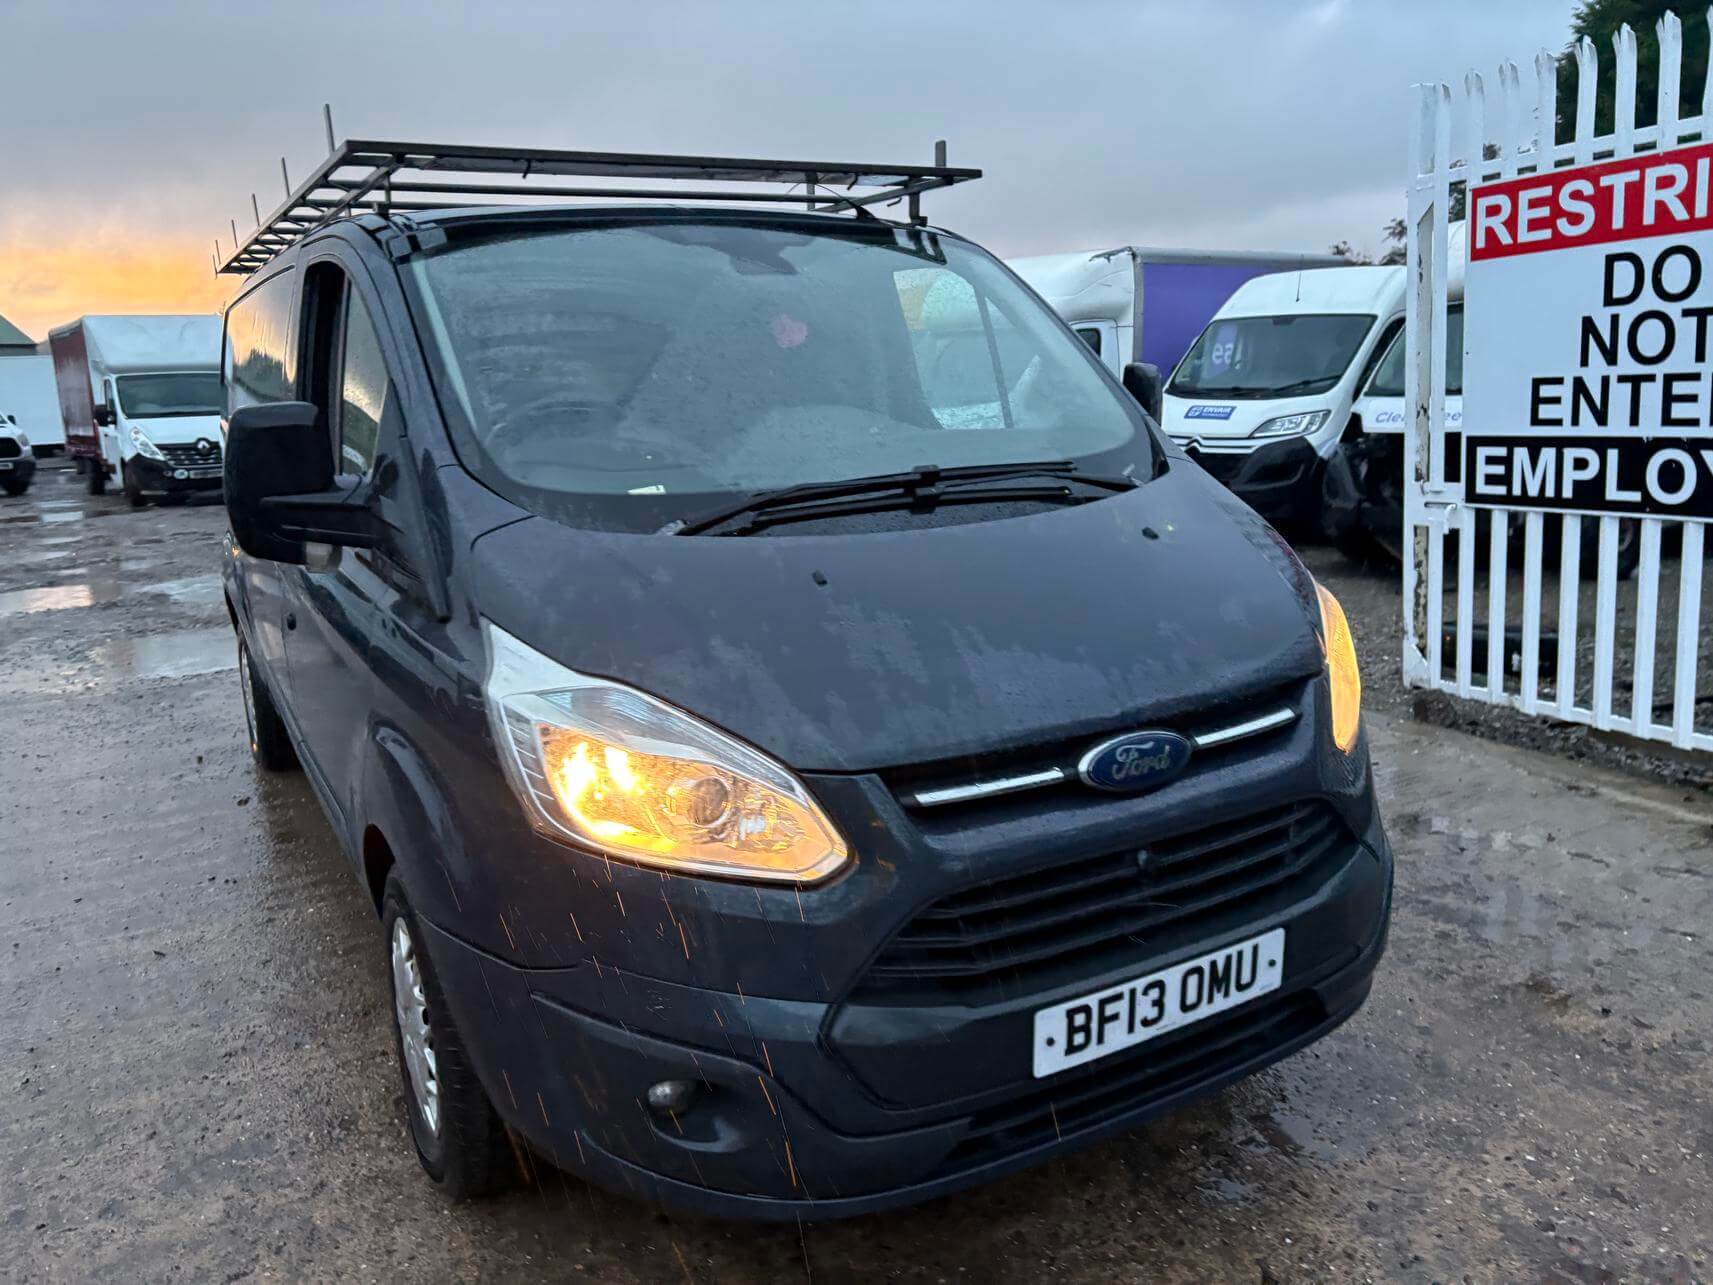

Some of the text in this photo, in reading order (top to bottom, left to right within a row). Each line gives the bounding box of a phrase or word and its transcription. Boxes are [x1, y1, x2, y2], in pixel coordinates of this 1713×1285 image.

[1603, 245, 1702, 308] DO
[1580, 307, 1713, 367] NOT
[1530, 372, 1713, 427] ENTE
[1112, 741, 1170, 780] Ford
[1065, 944, 1258, 1056] BF13 OMU
